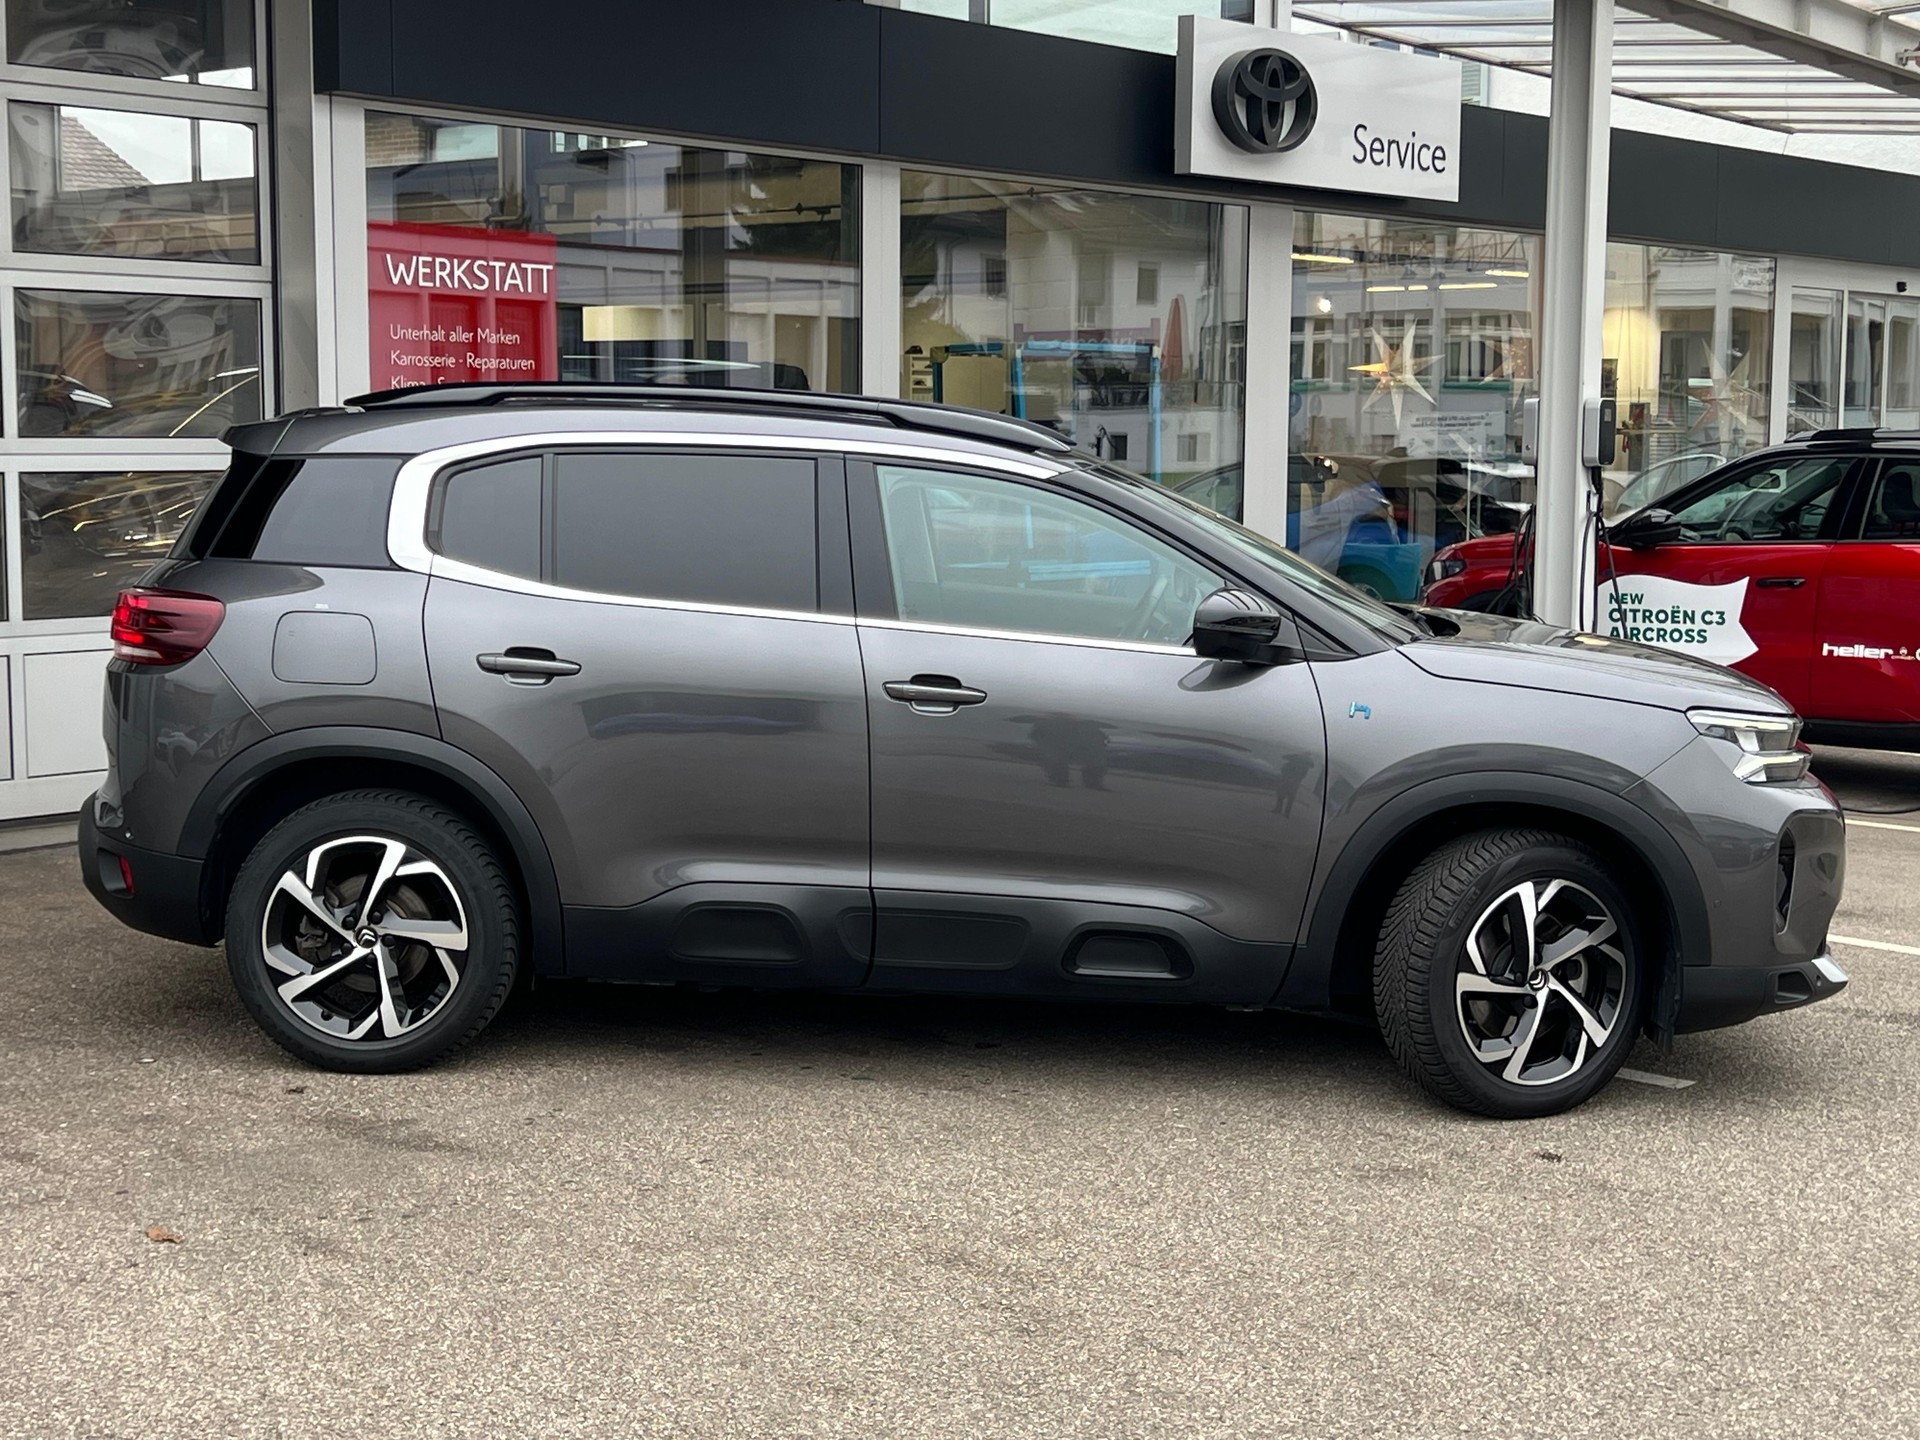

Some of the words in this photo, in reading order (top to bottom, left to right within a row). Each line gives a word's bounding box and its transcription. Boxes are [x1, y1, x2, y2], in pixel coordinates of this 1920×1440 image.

[1352, 123, 1446, 173] Service
[386, 253, 553, 293] WERKSTATT
[390, 323, 446, 342] Unterhalt
[449, 325, 474, 342] aller
[477, 328, 520, 345] Marken
[390, 350, 456, 368] Karrosserie
[466, 352, 536, 372] Reparaturen
[1608, 592, 1644, 605] NEW
[1701, 610, 1726, 626] C3
[1610, 626, 1708, 643] ARCROSS
